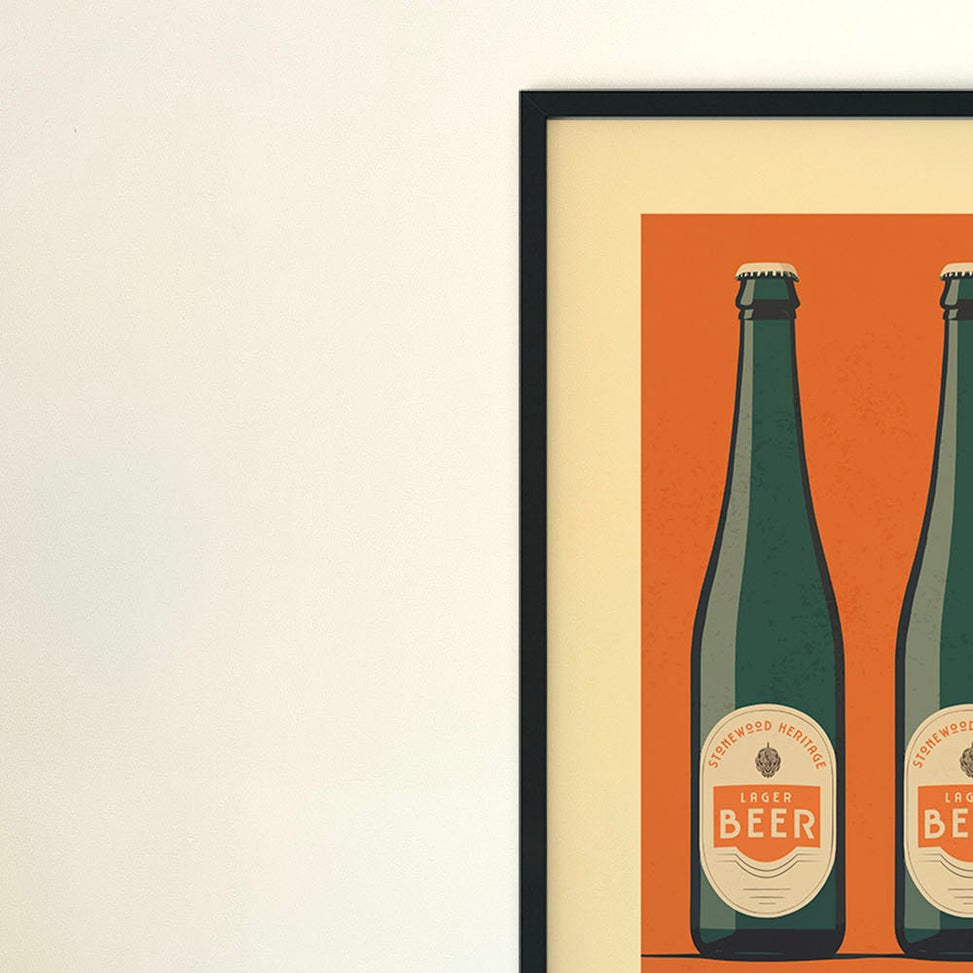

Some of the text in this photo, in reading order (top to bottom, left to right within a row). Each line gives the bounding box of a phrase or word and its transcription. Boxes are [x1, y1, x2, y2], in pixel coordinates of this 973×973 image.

[708, 721, 827, 769] STONEWOOD HERITAGE
[741, 792, 792, 802] LAGER
[720, 808, 815, 839] BEER
